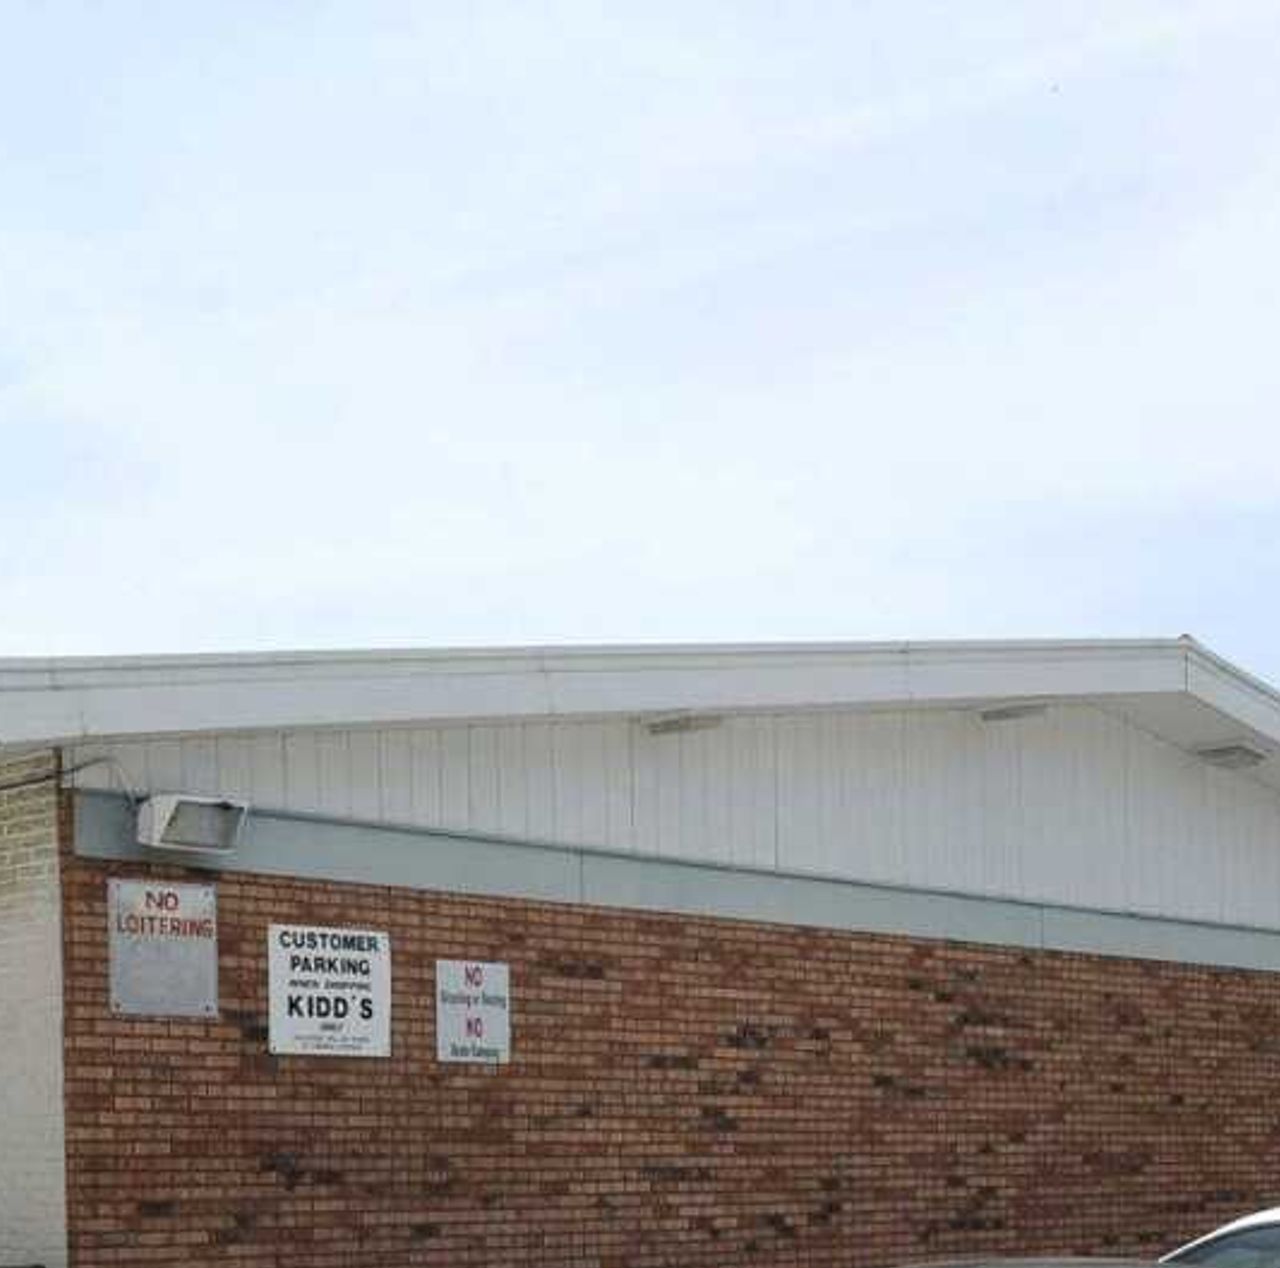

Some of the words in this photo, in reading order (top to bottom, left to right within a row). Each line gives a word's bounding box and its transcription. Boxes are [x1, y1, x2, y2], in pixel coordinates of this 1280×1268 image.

[145, 890, 179, 911] NO
[117, 914, 215, 938] LOITERING
[279, 931, 379, 952] CUSTOMER
[290, 955, 370, 975] PARKING
[464, 965, 483, 988] NO
[287, 995, 373, 1019] KIDD'S
[465, 1017, 483, 1038] NO
